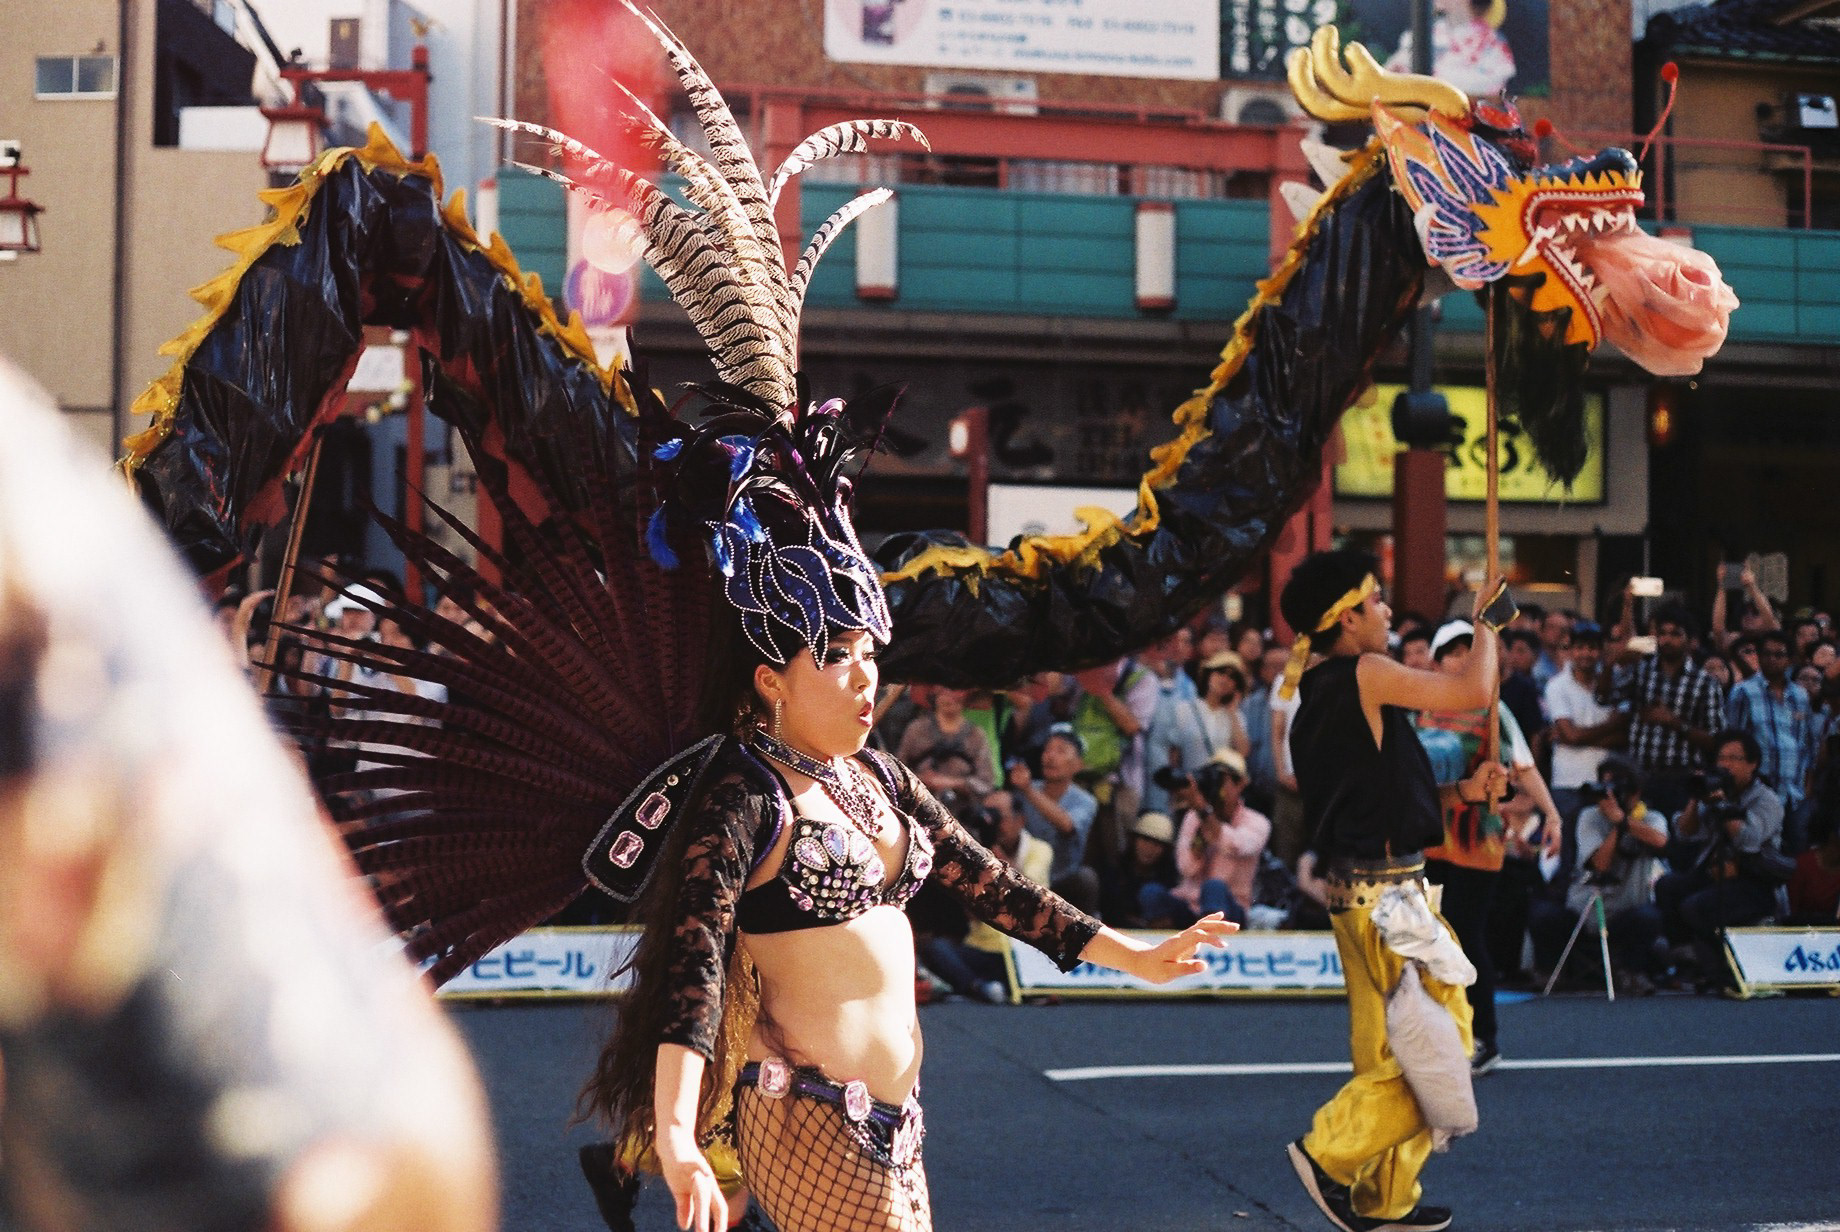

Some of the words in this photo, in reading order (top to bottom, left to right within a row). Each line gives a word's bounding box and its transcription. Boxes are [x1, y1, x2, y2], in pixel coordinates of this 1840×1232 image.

[422, 950, 597, 979] ヒビール
[1193, 951, 1343, 977] サヒビール
[1784, 944, 1840, 971] Asa
